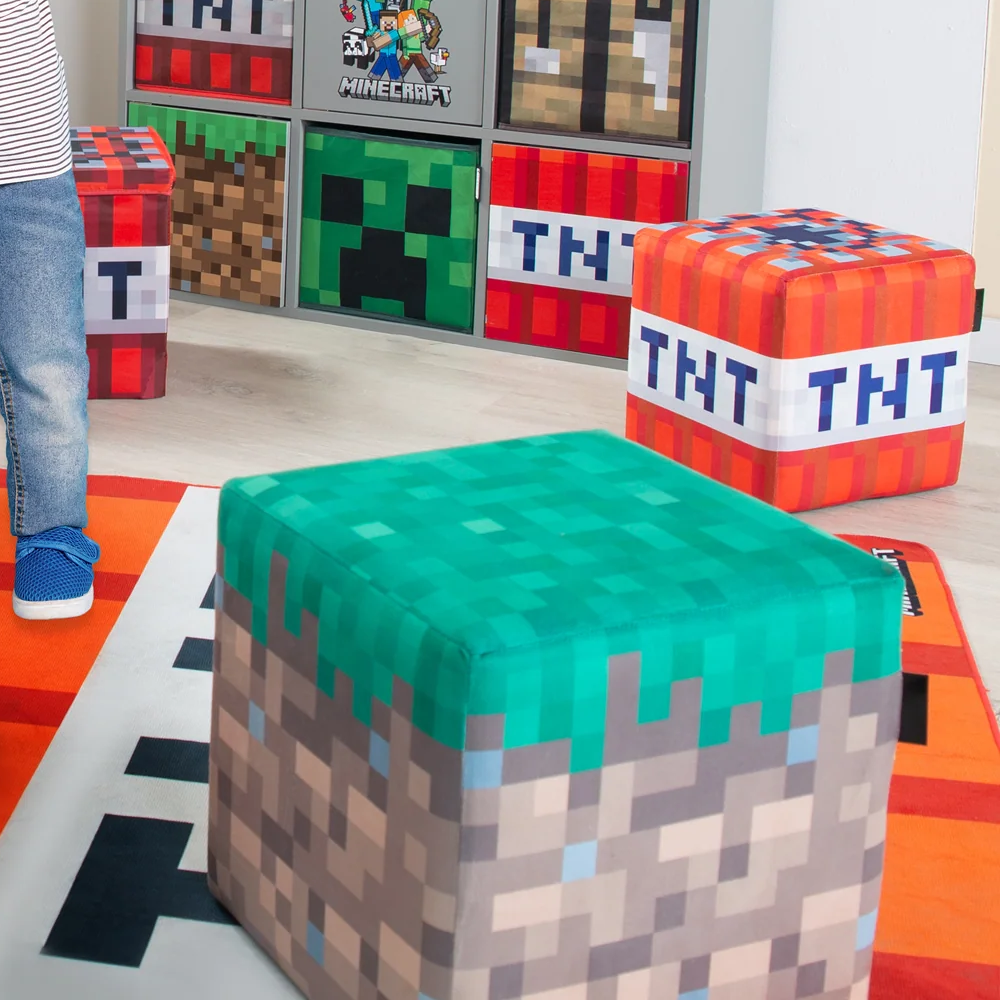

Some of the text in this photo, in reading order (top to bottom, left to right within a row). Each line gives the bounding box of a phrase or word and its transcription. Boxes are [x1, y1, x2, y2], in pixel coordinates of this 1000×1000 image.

[338, 76, 451, 107] MINECRAFT
[512, 219, 634, 282] TN
[640, 325, 758, 426] TNT
[808, 350, 958, 432] TNT
